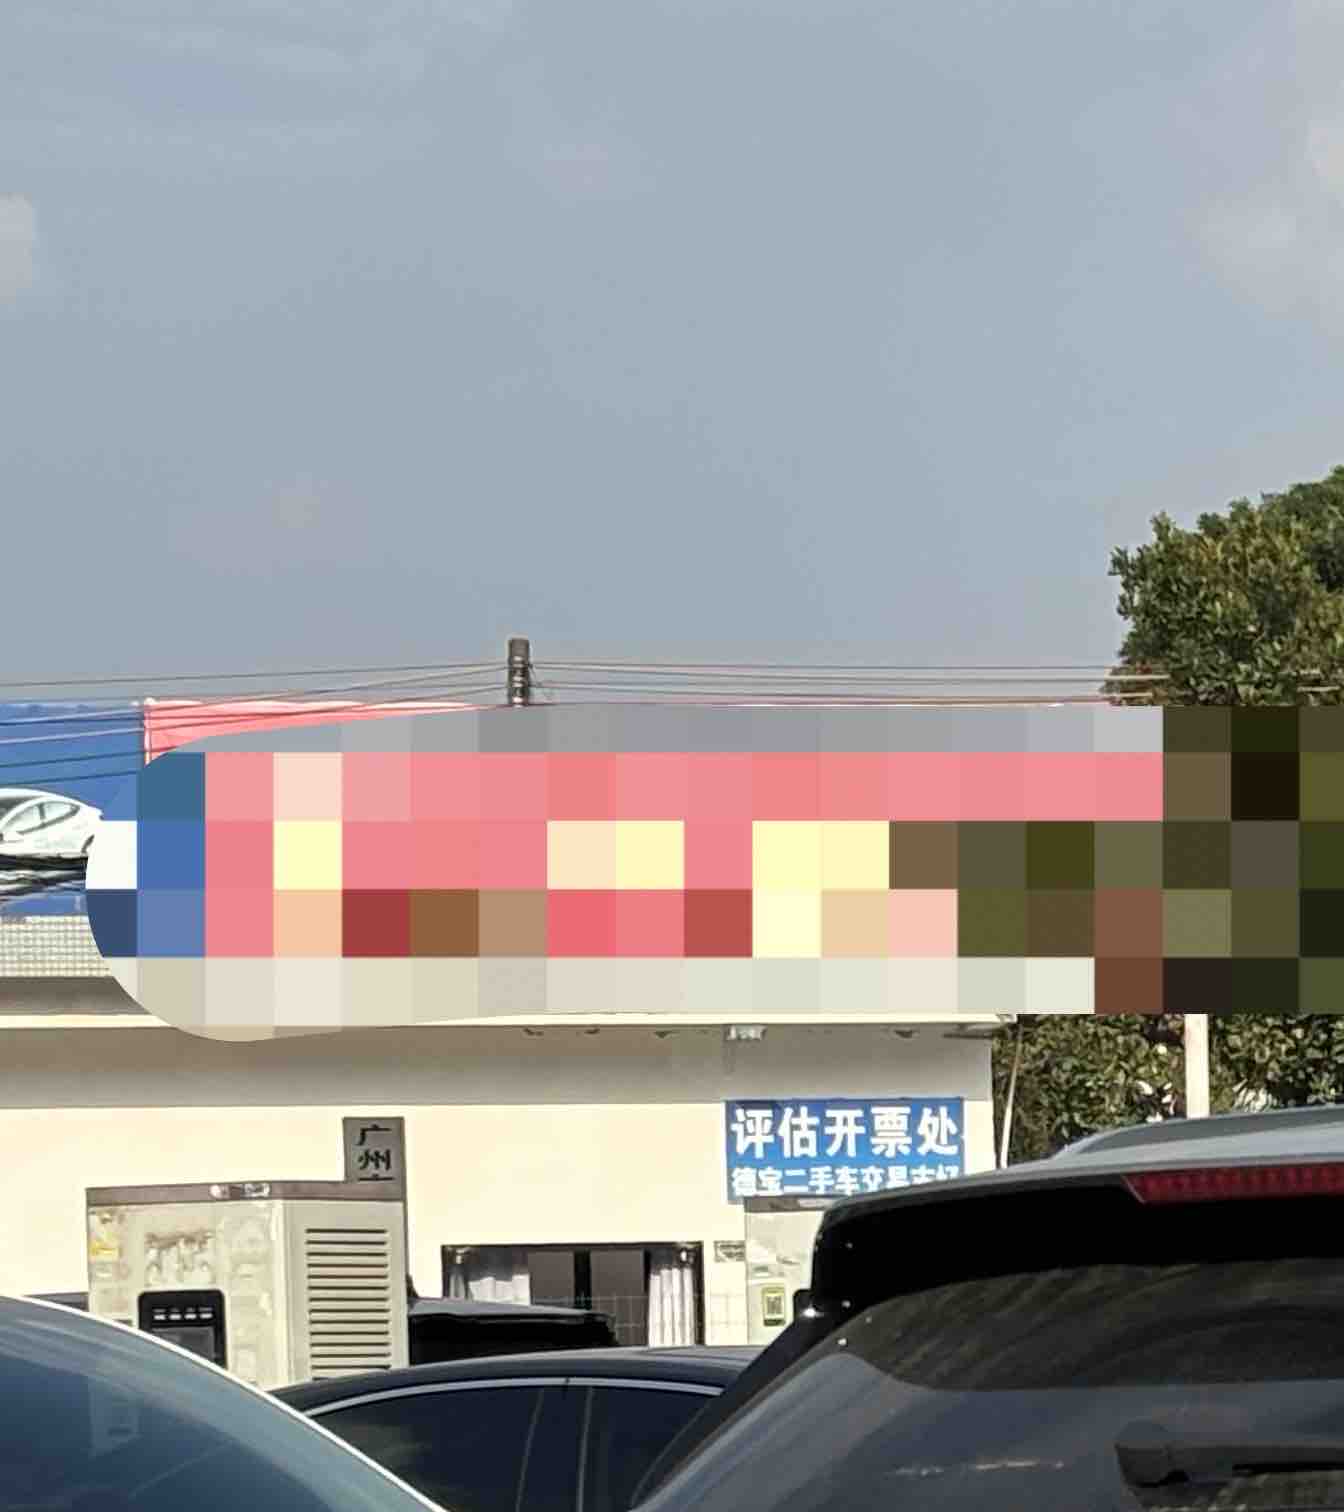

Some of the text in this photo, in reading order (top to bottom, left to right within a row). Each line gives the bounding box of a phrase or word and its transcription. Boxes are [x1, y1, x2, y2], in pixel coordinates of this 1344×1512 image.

[354, 1123, 395, 1182] 广州
[731, 1105, 958, 1158] 评估开票处
